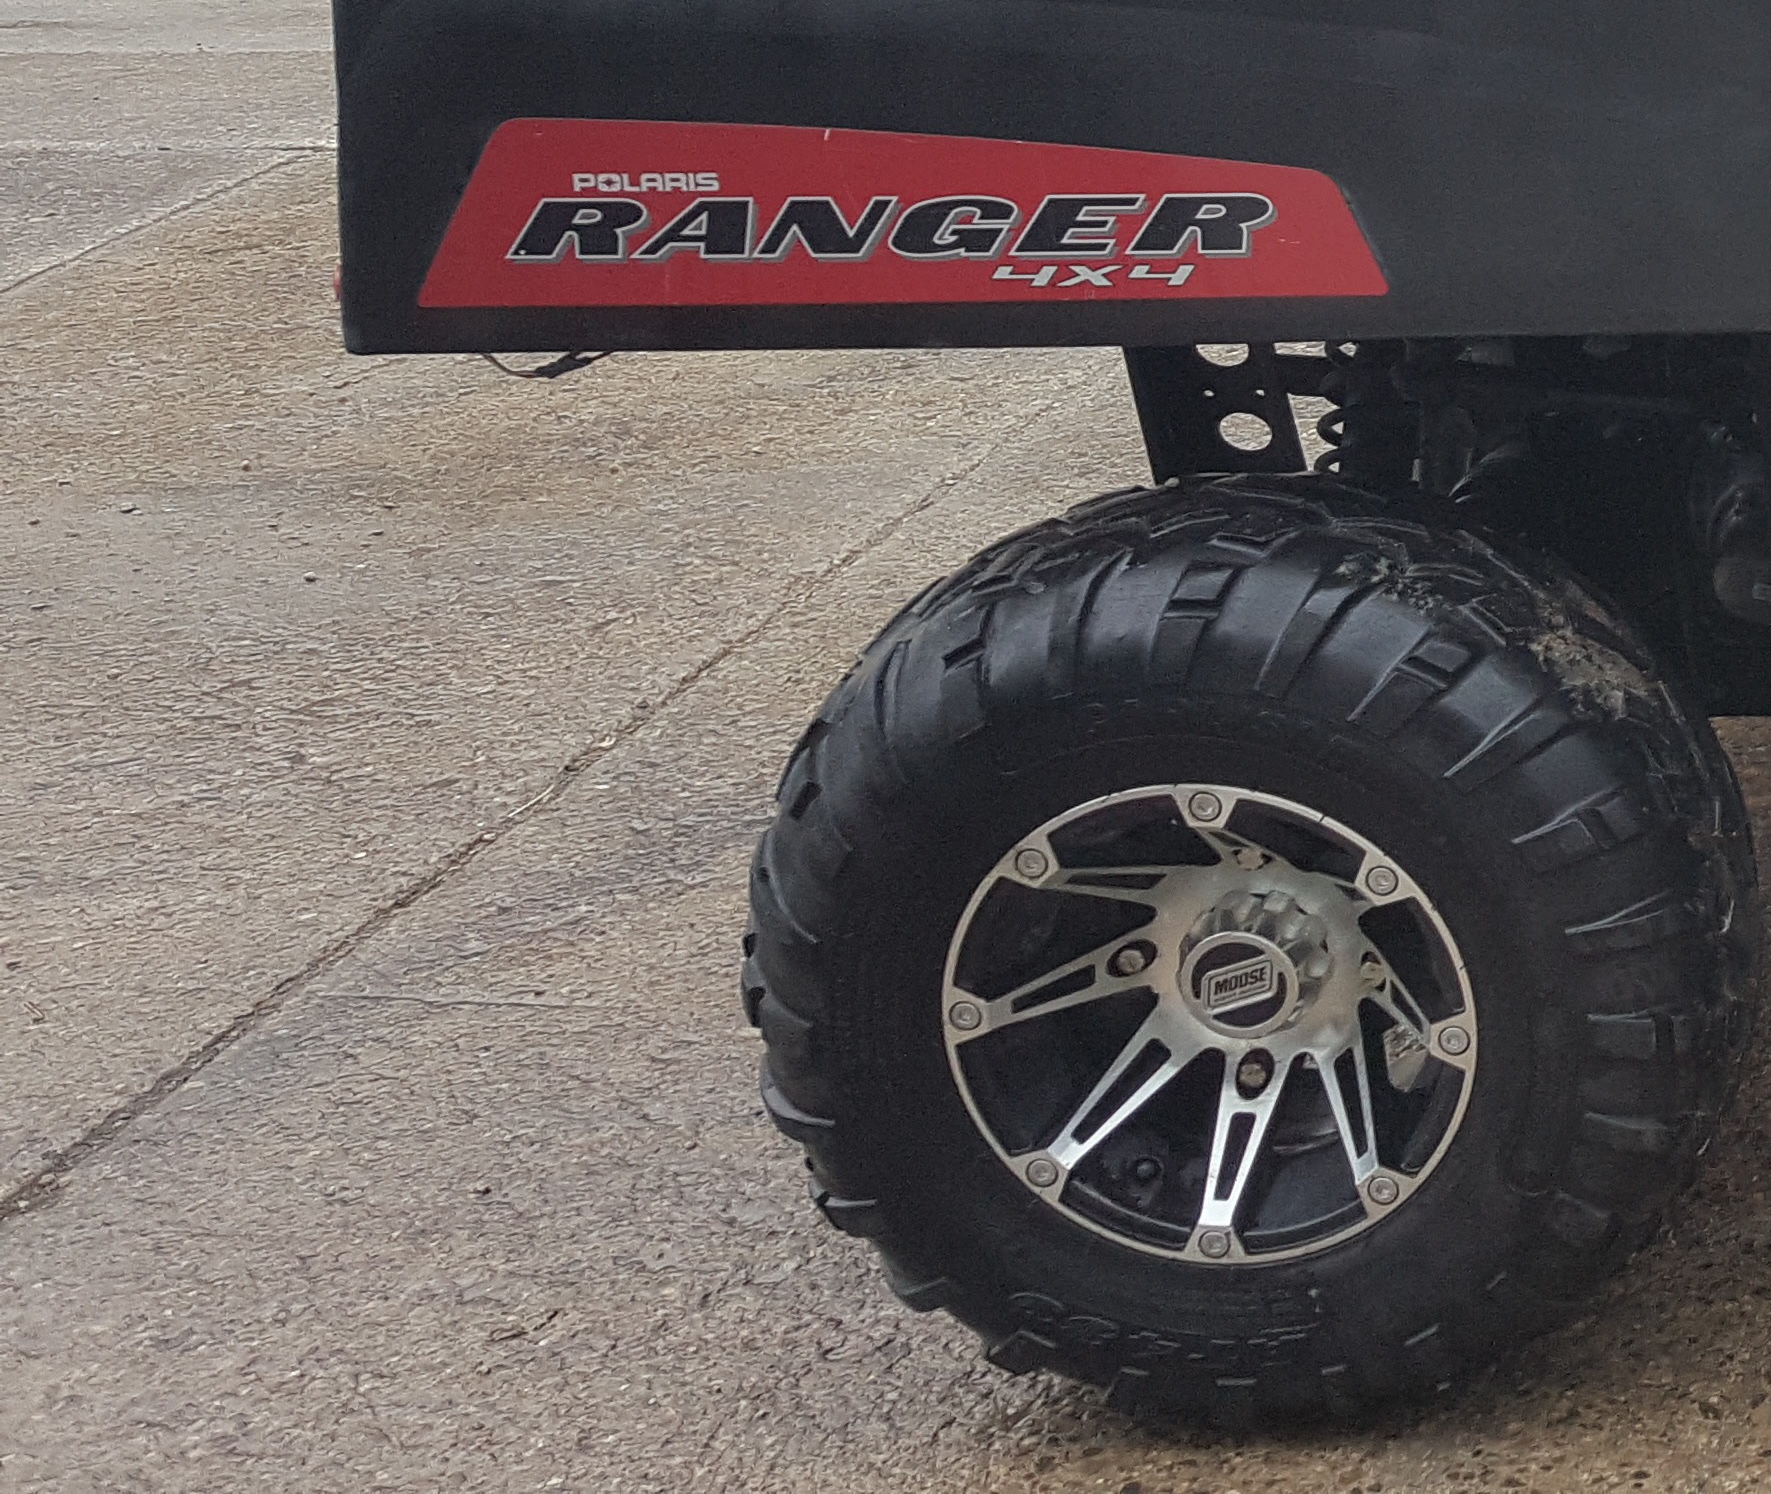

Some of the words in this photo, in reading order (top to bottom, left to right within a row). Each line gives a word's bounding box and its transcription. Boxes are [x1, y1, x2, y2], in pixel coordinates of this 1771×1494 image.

[572, 173, 720, 192] POLARIS
[505, 192, 1278, 263] RANGER
[1213, 966, 1267, 996] MOOSE
